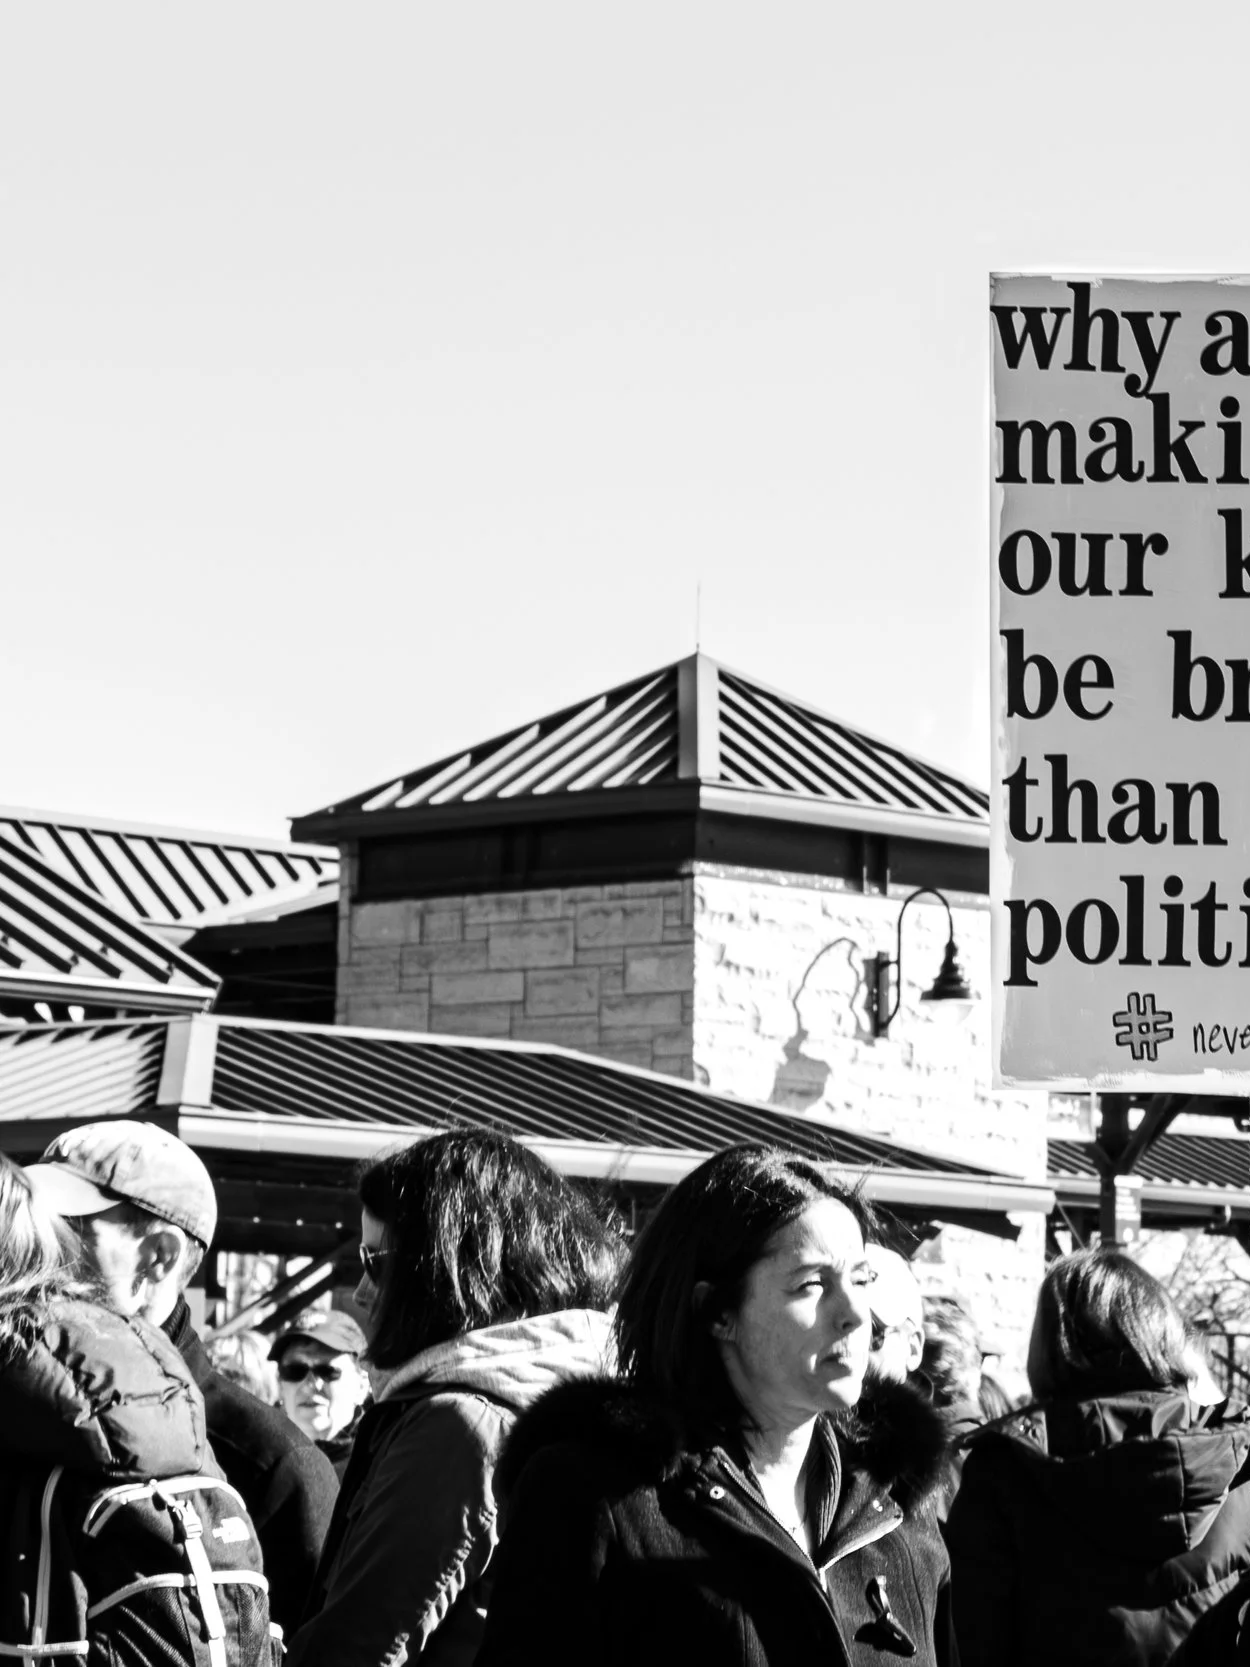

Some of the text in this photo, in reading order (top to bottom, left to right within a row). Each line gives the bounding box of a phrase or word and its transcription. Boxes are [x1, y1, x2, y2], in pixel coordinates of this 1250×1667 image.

[990, 281, 1182, 399] why
[998, 528, 1169, 597] our
[1000, 628, 1115, 721] be
[1001, 753, 1228, 847] than
